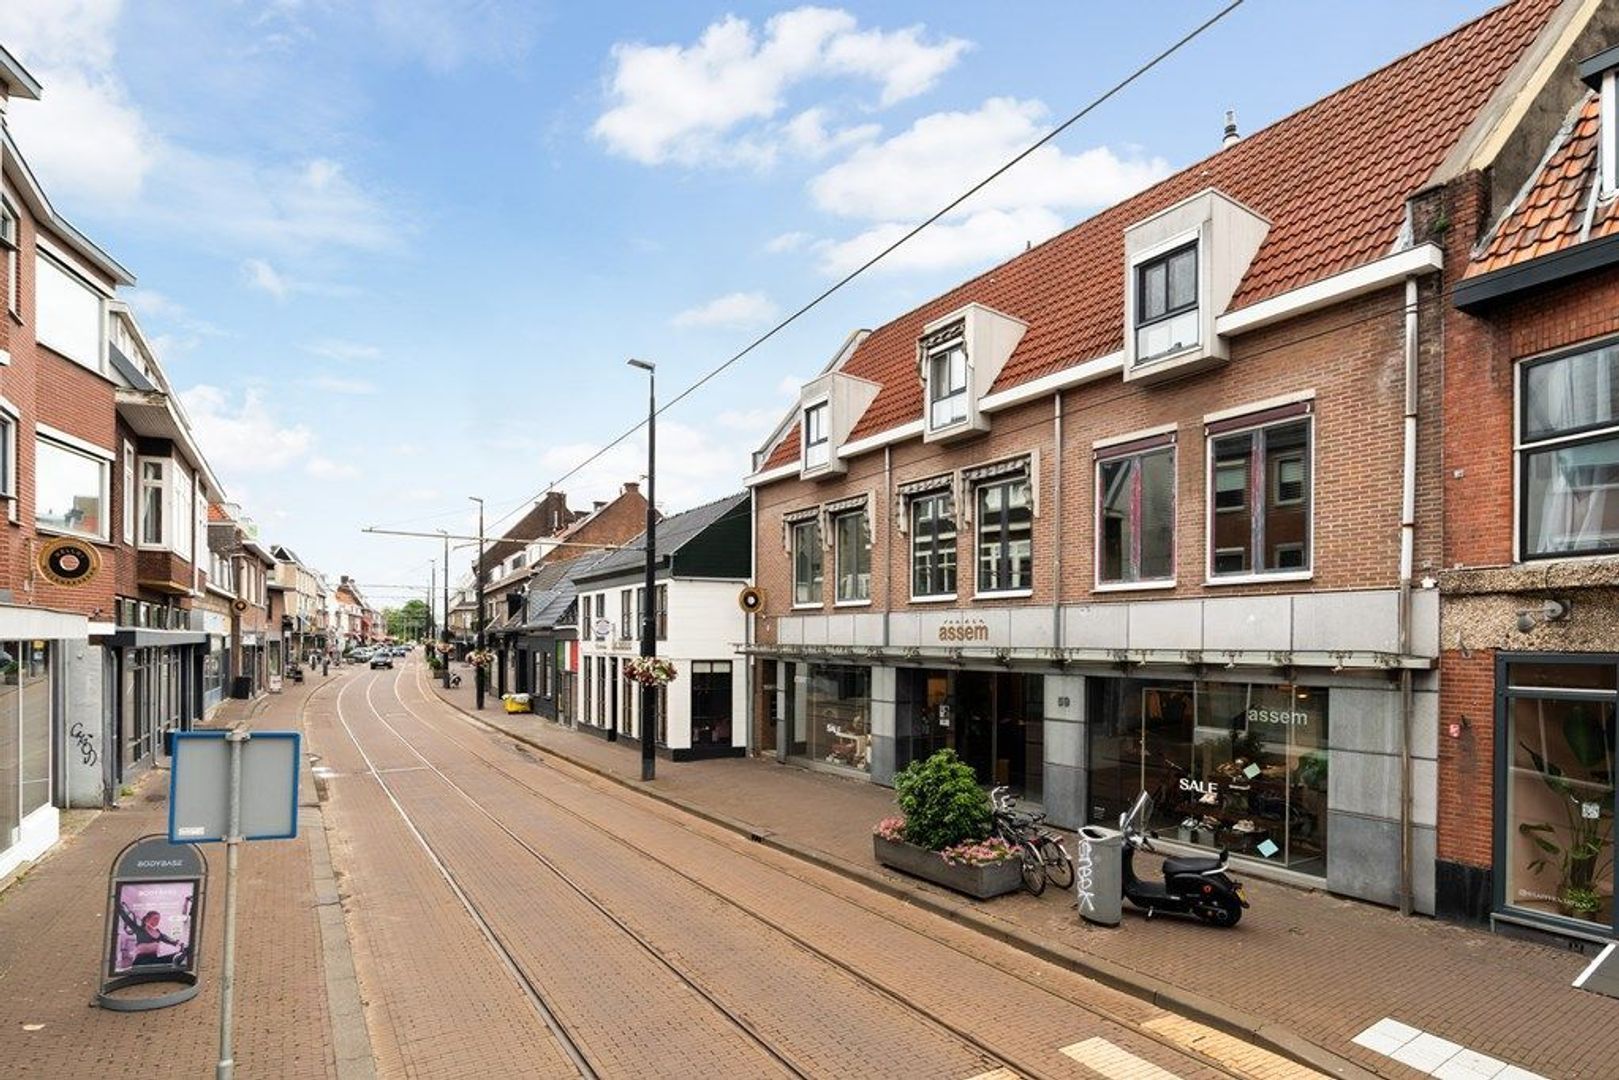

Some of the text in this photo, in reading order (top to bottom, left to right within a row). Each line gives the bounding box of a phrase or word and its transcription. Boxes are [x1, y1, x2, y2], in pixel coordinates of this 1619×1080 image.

[939, 625, 989, 641] assem
[1248, 709, 1308, 725] assem
[1179, 778, 1219, 796] SALE
[137, 859, 184, 869] BODYBASE
